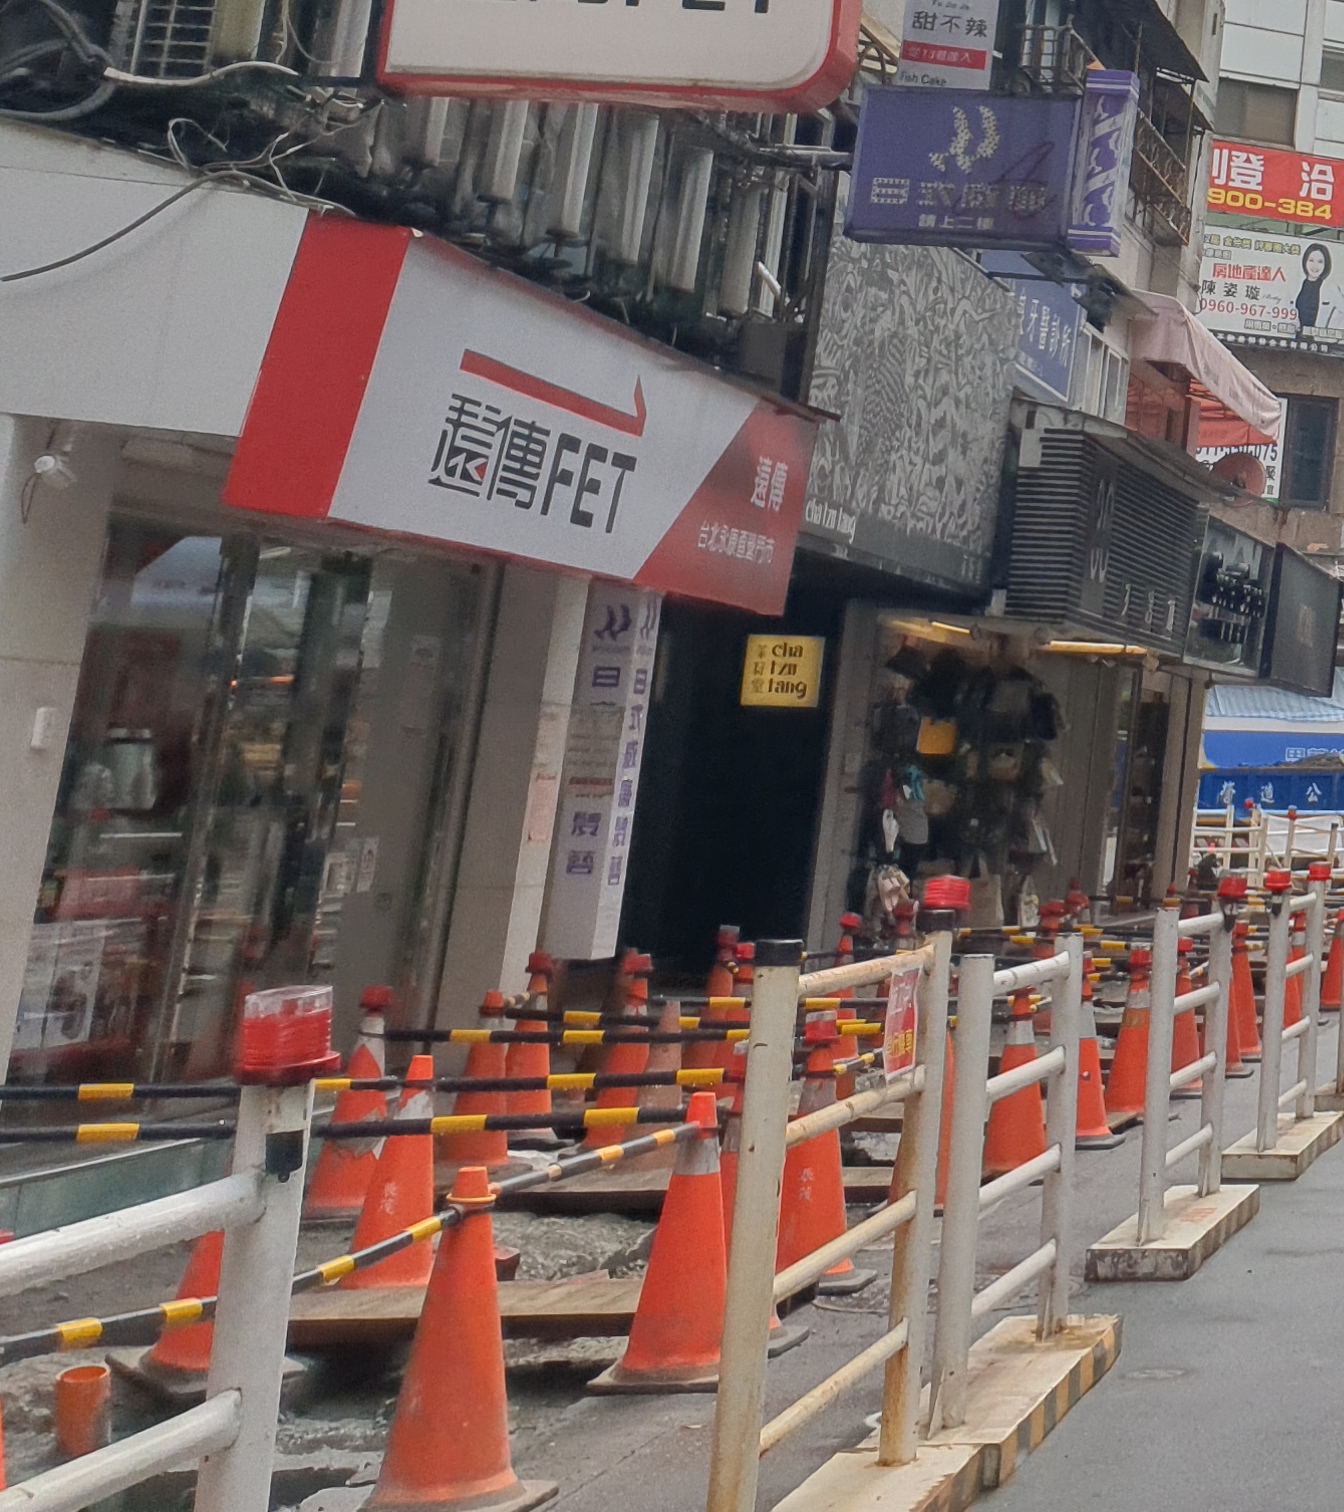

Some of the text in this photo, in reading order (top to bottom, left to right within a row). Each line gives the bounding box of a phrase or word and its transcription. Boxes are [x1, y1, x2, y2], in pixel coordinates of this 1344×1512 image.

[912, 11, 988, 37] 甜不辣
[1300, 161, 1334, 201] 洽
[1212, 263, 1287, 283] 房地產達人
[1200, 297, 1298, 320] 0960-967-999
[427, 392, 637, 534] 遠傳 FET
[772, 642, 804, 658] cha
